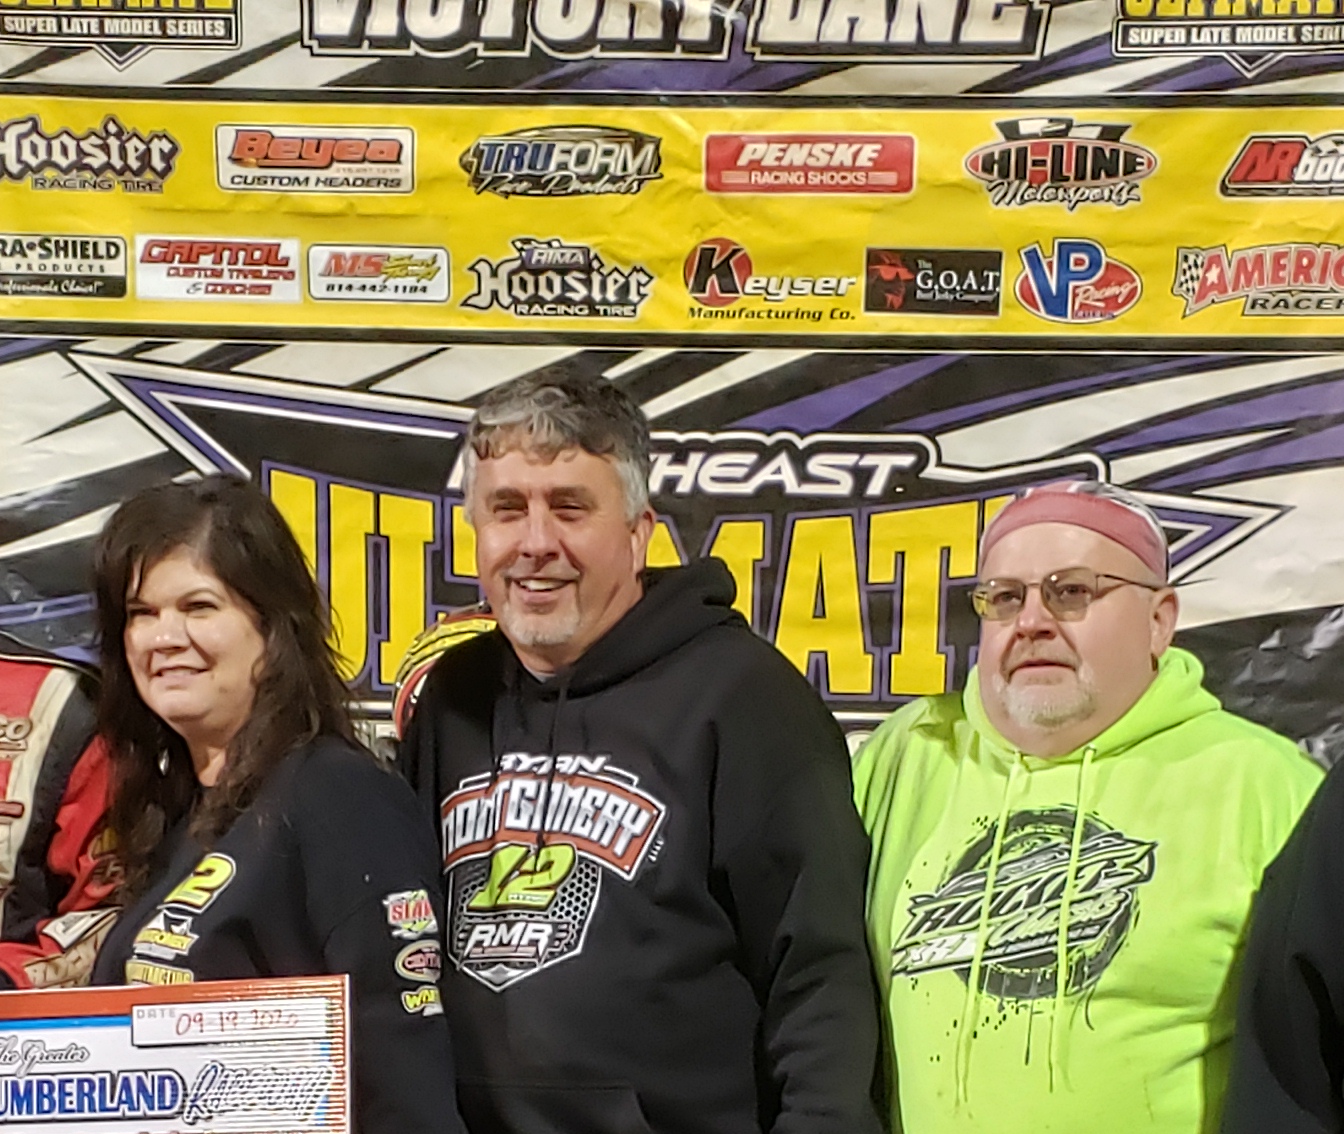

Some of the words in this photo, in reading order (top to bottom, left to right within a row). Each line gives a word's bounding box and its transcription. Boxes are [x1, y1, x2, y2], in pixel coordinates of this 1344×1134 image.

[4, 17, 56, 34] SUPER
[61, 17, 100, 35] LATE
[105, 18, 162, 36] MODEL
[166, 19, 226, 37] SERIES
[1128, 26, 1186, 45] SUPER
[1190, 26, 1232, 44] LATE
[1235, 25, 1296, 43] MODEL
[230, 130, 403, 169] Beyea
[477, 139, 657, 175] TRUFORM
[736, 142, 883, 168] PENSKE
[980, 144, 1148, 182] HI-LINE
[33, 177, 114, 191] RACING
[230, 174, 310, 188] CUSTOM
[315, 176, 403, 189] HEADERS
[749, 171, 806, 186] RACING
[807, 171, 868, 186] SHOCKS
[140, 239, 290, 267] CAPITOL
[15, 263, 106, 274] PRODUCTS
[688, 245, 857, 301] Keyser
[1019, 238, 1104, 319] VP
[1074, 280, 1138, 308] Racing
[461, 257, 653, 309] Hoosier
[516, 304, 591, 316] RACING
[595, 305, 636, 316] TIRE
[688, 307, 823, 321] Manufacturing
[829, 308, 856, 320] Co.
[465, 841, 578, 914] 12
[464, 922, 554, 960] RMR
[136, 1008, 176, 1019] DATE
[18, 1038, 91, 1076] Greater
